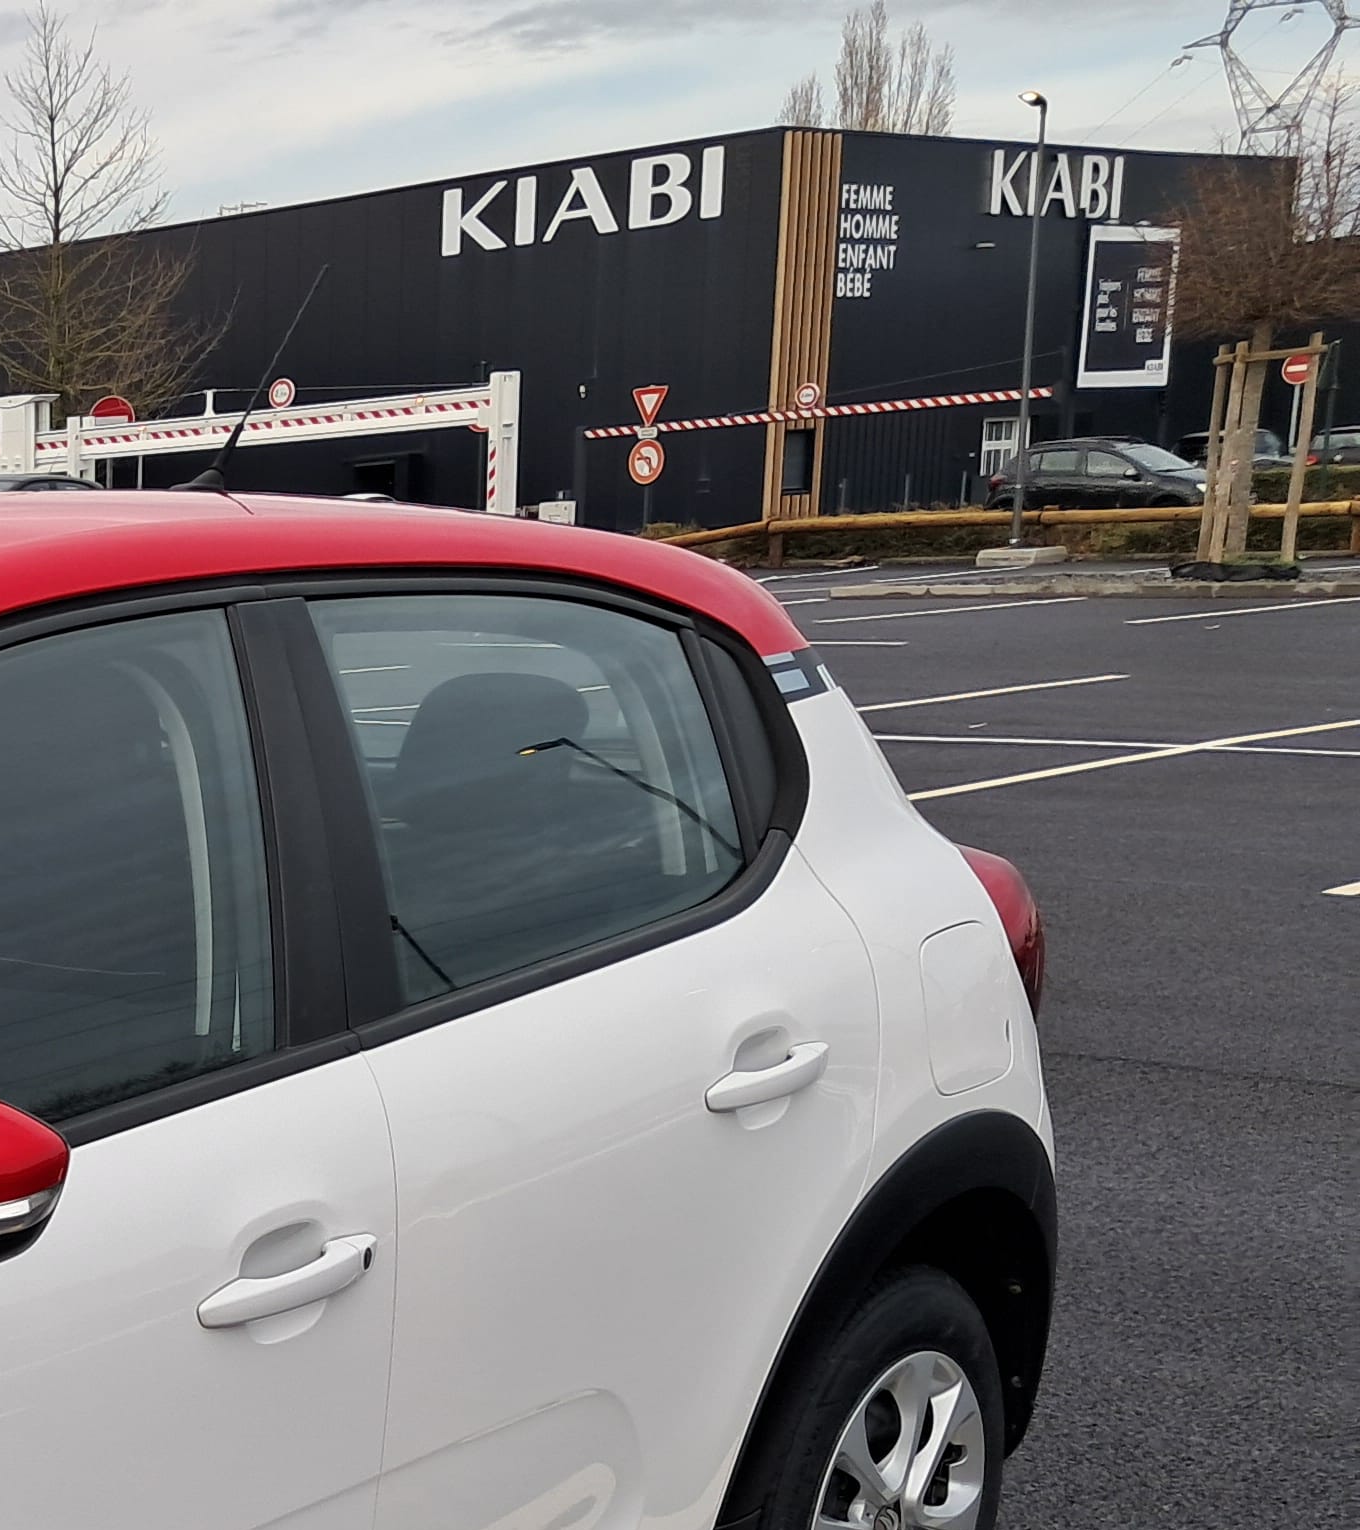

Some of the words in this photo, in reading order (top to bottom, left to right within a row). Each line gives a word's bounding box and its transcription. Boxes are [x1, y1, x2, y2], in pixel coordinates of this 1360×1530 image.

[841, 184, 894, 211] FEMME
[989, 149, 1125, 220] KIABI
[441, 145, 725, 257] KIABI
[839, 213, 900, 241] HOMME
[838, 244, 896, 270] ENFANT
[836, 266, 872, 298] BÉBÉ
